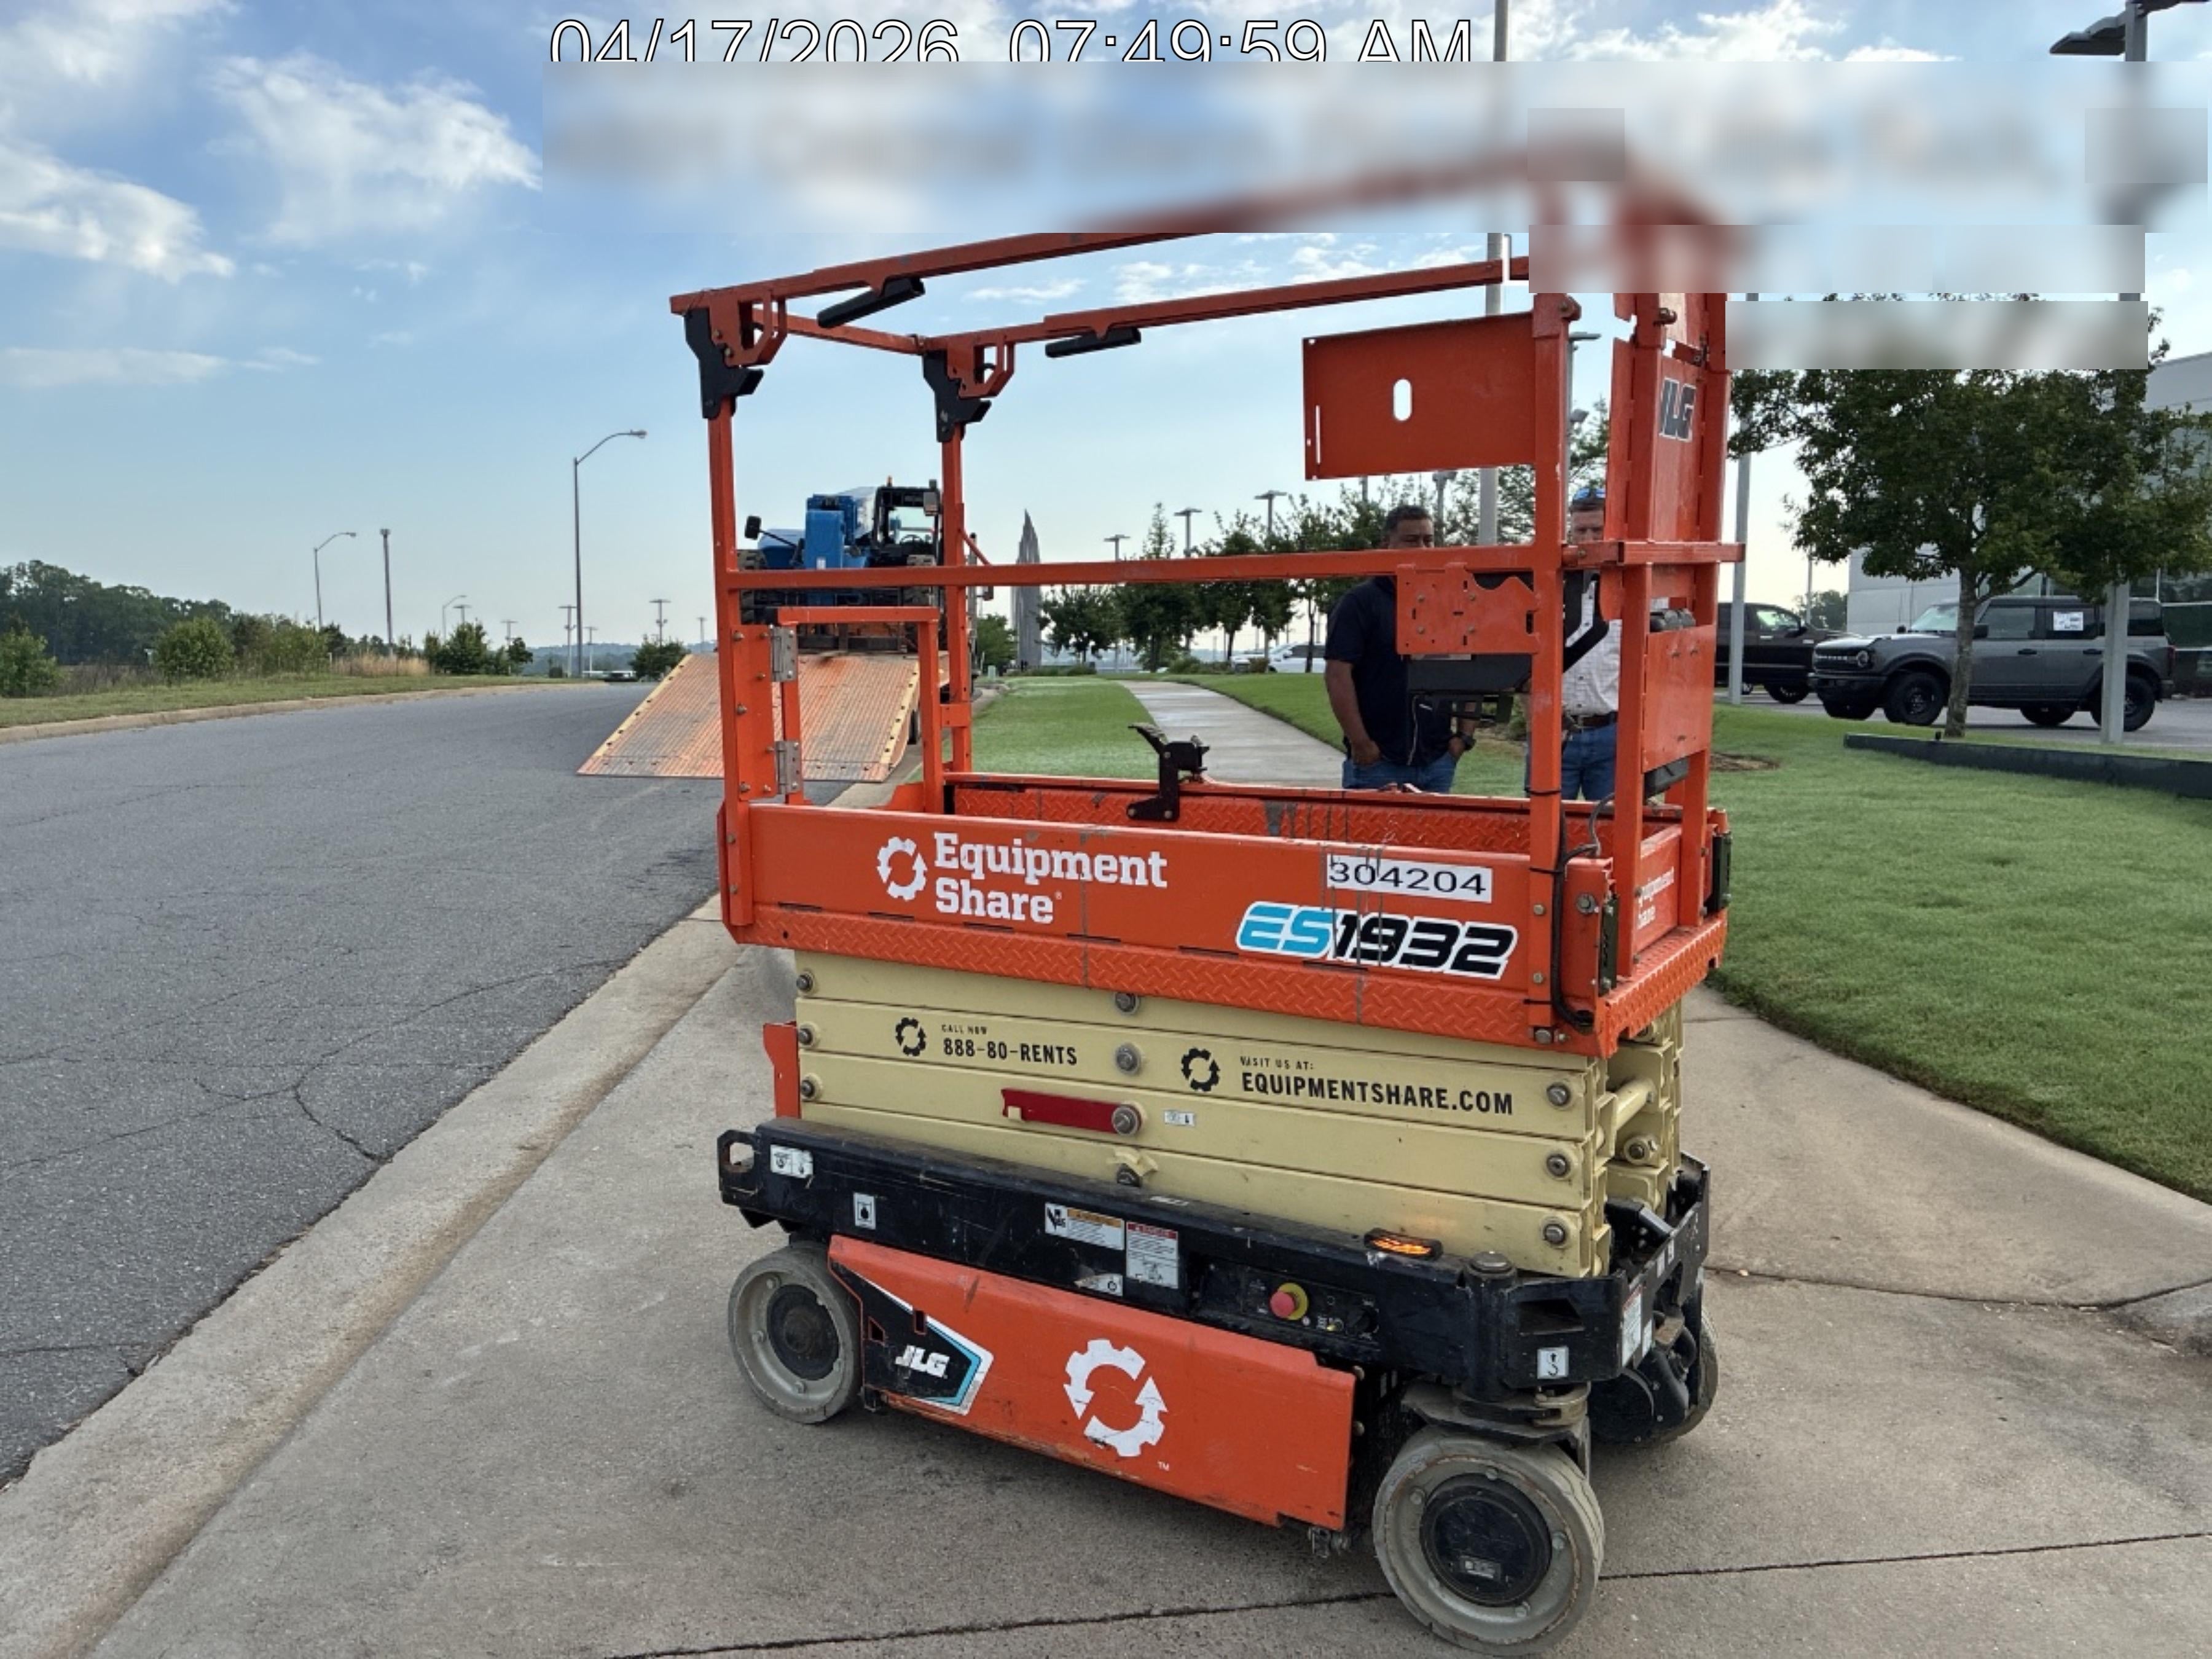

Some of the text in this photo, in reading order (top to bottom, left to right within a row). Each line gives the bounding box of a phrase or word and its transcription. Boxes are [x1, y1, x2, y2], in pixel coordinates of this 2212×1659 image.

[933, 831, 1168, 888] Equipment
[1328, 861, 1486, 895] 304204
[935, 877, 1054, 924] Share
[1236, 901, 1517, 979] ES1932
[941, 1024, 987, 1035] CALL NOW
[943, 1037, 1077, 1065] 888-80-RENTS
[1240, 1056, 1314, 1070] VISIT US AT:
[1241, 1072, 1513, 1115] EQUIPMENTSHARE.COM
[895, 1344, 950, 1378] JLG
